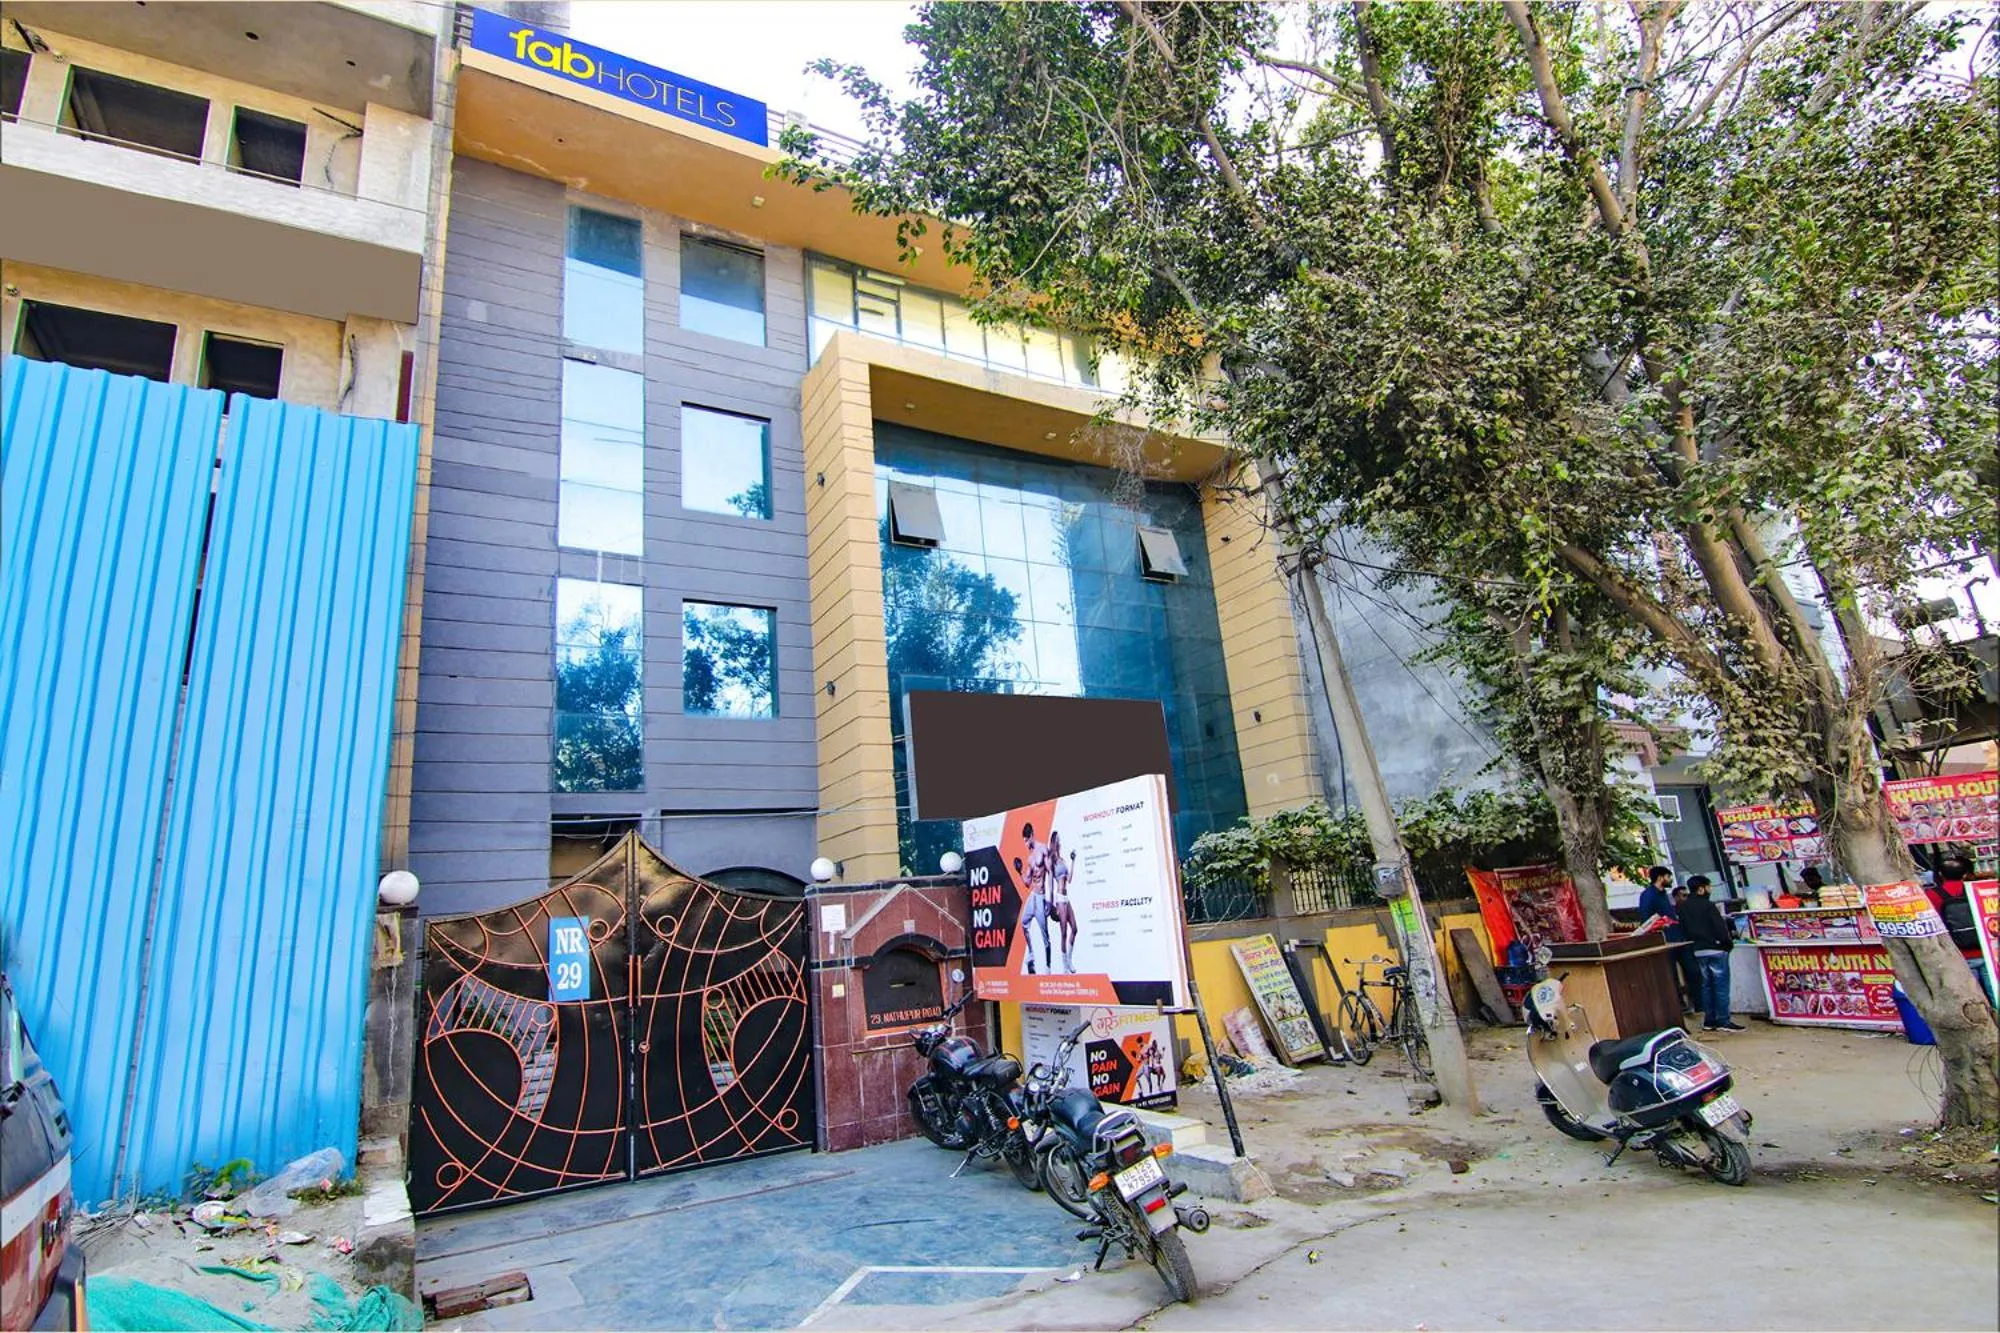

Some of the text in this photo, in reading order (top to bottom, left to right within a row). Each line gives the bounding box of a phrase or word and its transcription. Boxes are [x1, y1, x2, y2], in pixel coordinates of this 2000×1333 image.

[1890, 785, 1954, 804] KHUSHI
[1083, 801, 1145, 822] WORKOUT FORMAT
[970, 866, 989, 887] NO
[972, 885, 1001, 907] PAIN
[1091, 896, 1152, 911] FITNESS FACILITY
[973, 908, 992, 928] NO
[555, 927, 584, 955] NR
[975, 928, 1006, 949] GAIN
[1767, 954, 1821, 971] KHUSHI
[557, 961, 582, 990] 29
[1090, 1050, 1107, 1063] NO
[1092, 1060, 1117, 1074] PAIN
[1092, 1073, 1110, 1086] NO
[1094, 1082, 1120, 1097] GAIN
